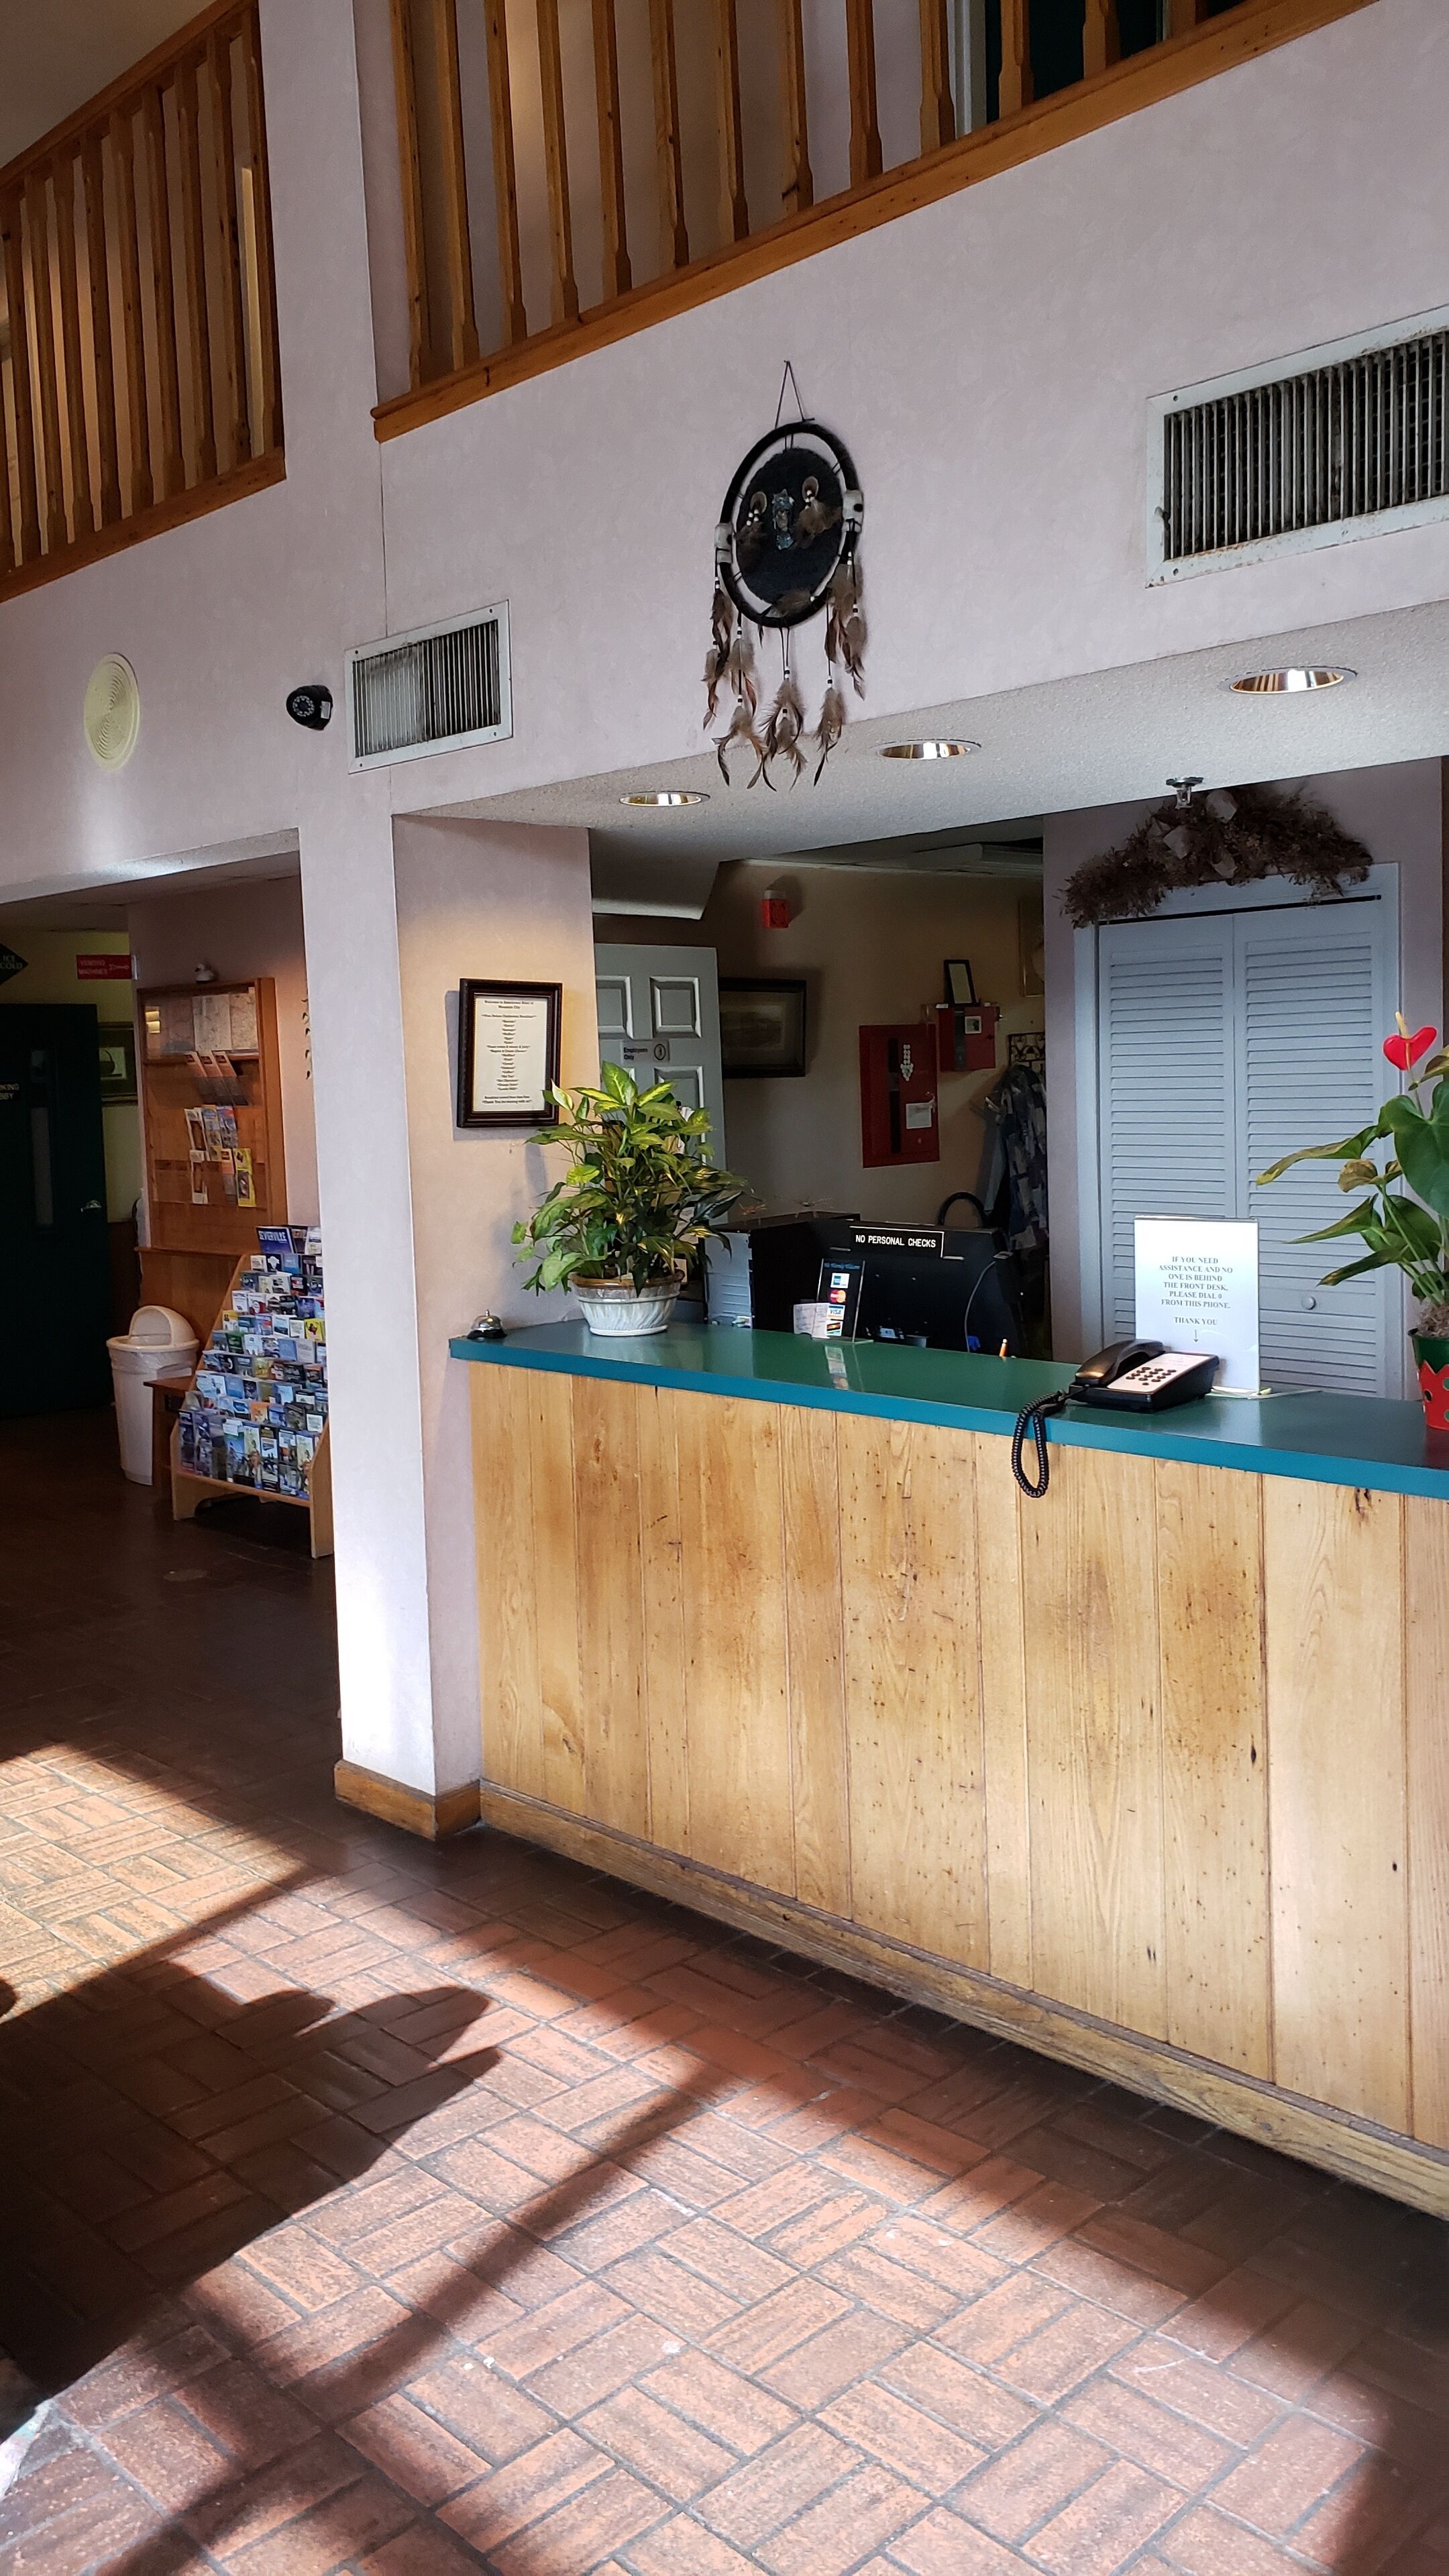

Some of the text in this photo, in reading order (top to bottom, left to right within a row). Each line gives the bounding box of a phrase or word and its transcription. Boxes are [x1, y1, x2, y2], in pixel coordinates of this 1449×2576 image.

[855, 1235, 936, 1247] NO PERSONAL CHECKS
